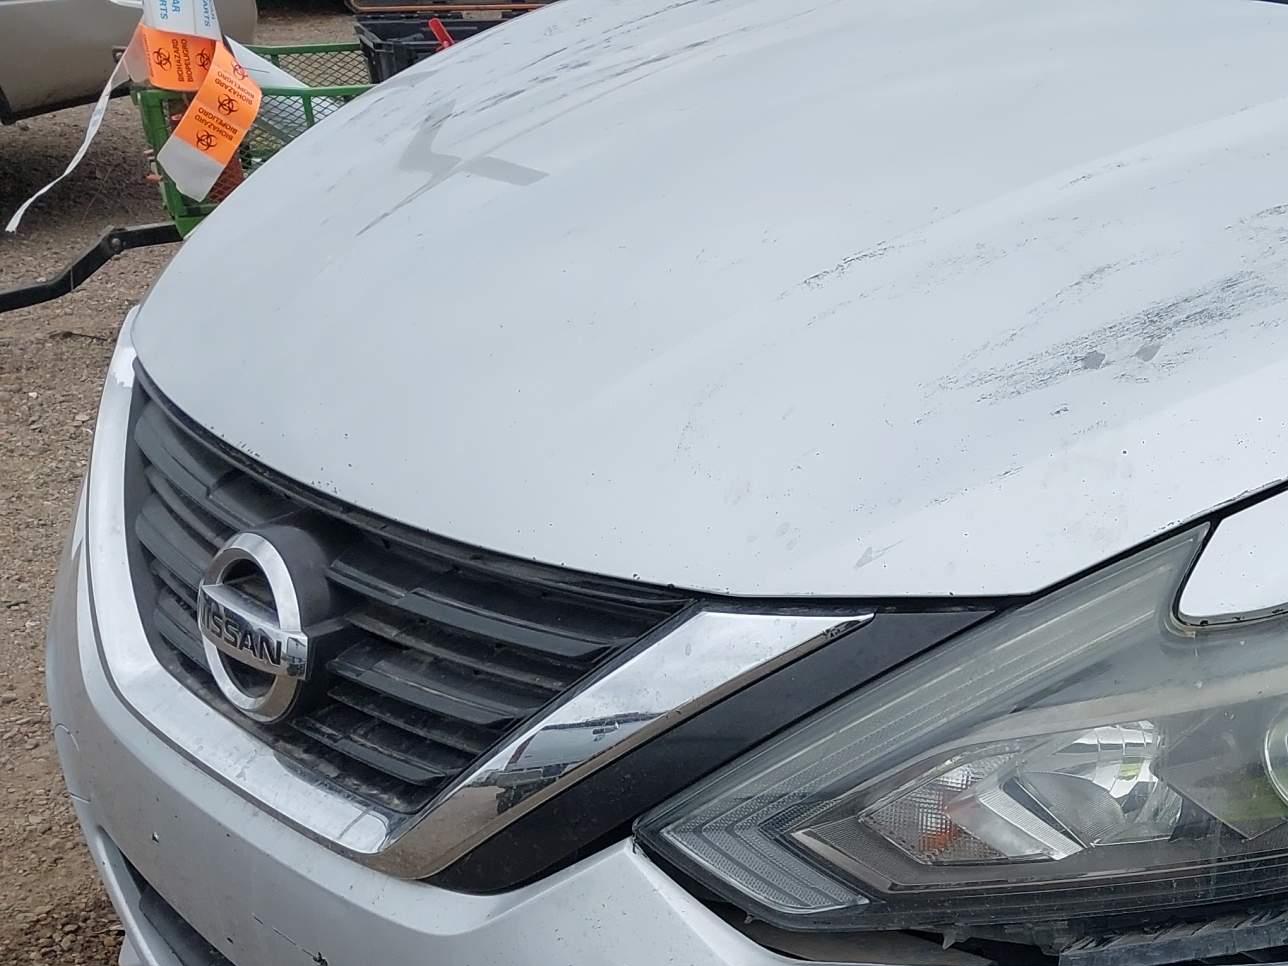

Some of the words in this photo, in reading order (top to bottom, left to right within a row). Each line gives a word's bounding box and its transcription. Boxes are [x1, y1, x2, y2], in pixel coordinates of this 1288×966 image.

[172, 39, 184, 82] BIOHAZARD
[181, 39, 194, 82] BIOPELIGRO
[215, 78, 253, 105] BIOHAZARD
[194, 114, 234, 141] BIOHAZARD
[198, 107, 238, 135] BIOPELIGRO
